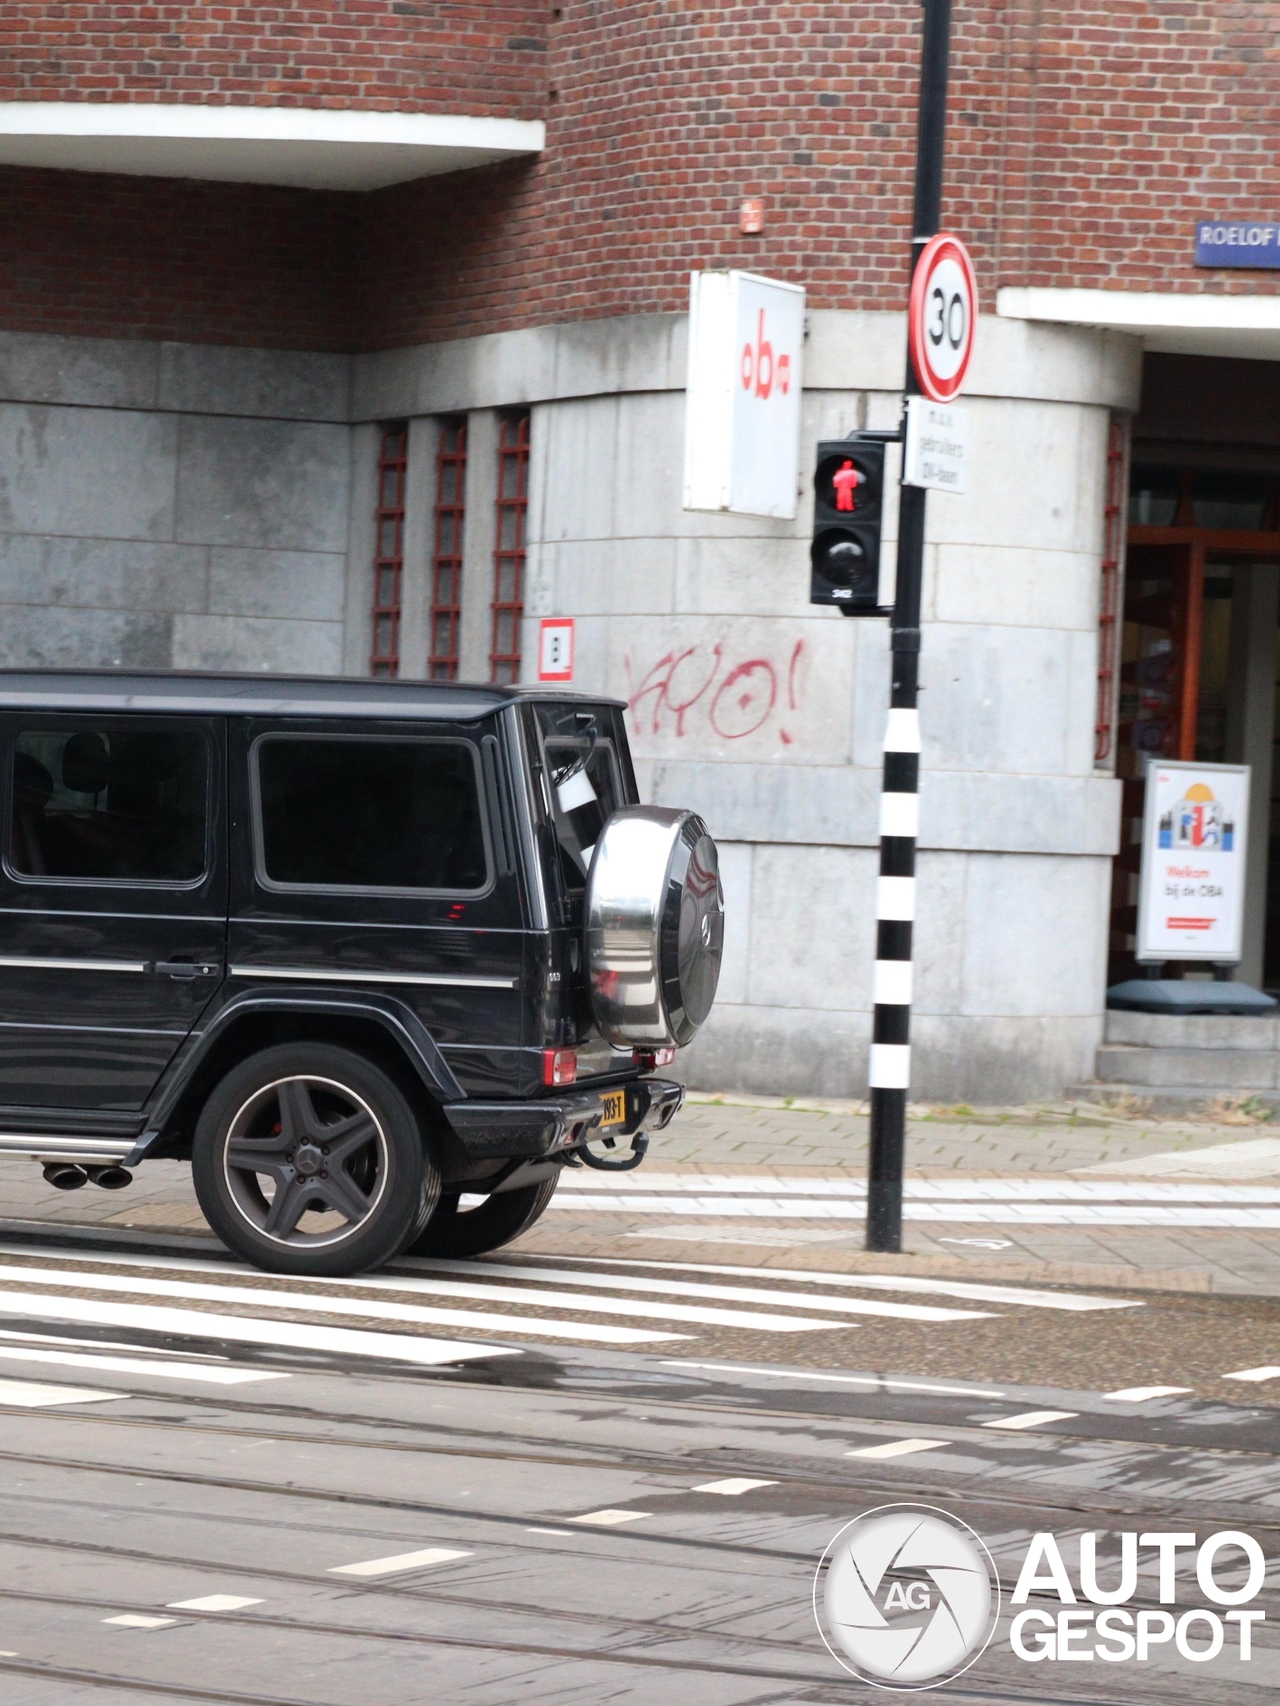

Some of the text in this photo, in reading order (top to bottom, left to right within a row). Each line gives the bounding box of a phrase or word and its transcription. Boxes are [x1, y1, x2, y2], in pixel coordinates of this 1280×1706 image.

[1200, 226, 1274, 246] ROELOF
[929, 287, 965, 351] 30
[741, 307, 791, 400] oba
